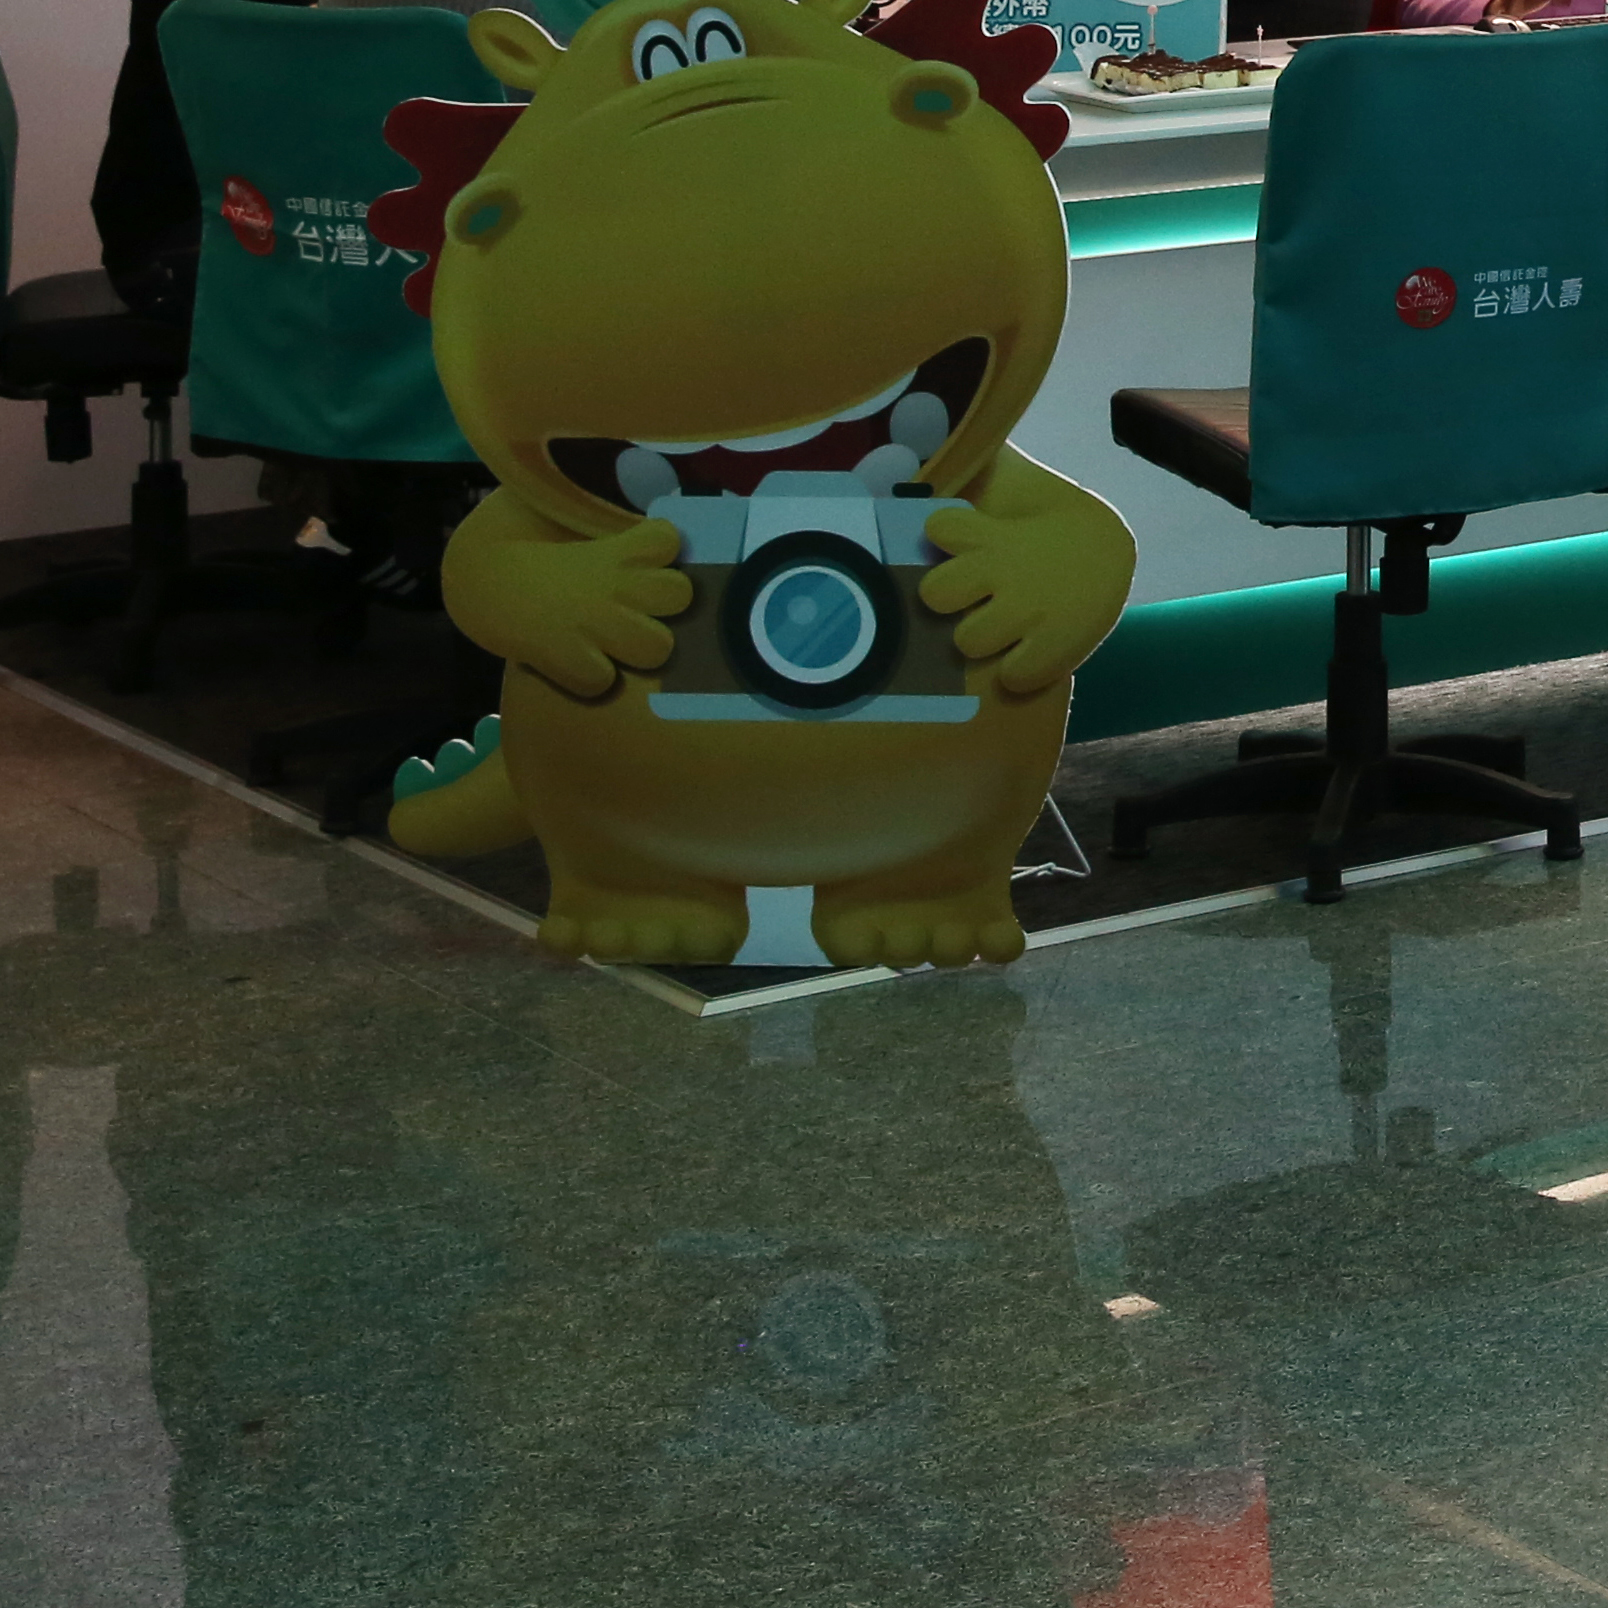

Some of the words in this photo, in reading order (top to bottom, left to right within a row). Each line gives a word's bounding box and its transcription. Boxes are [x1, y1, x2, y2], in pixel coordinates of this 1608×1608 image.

[285, 197, 369, 218] 中國信託金
[292, 221, 419, 267] 台灣人
[1473, 277, 1583, 318] 台灣人壽
